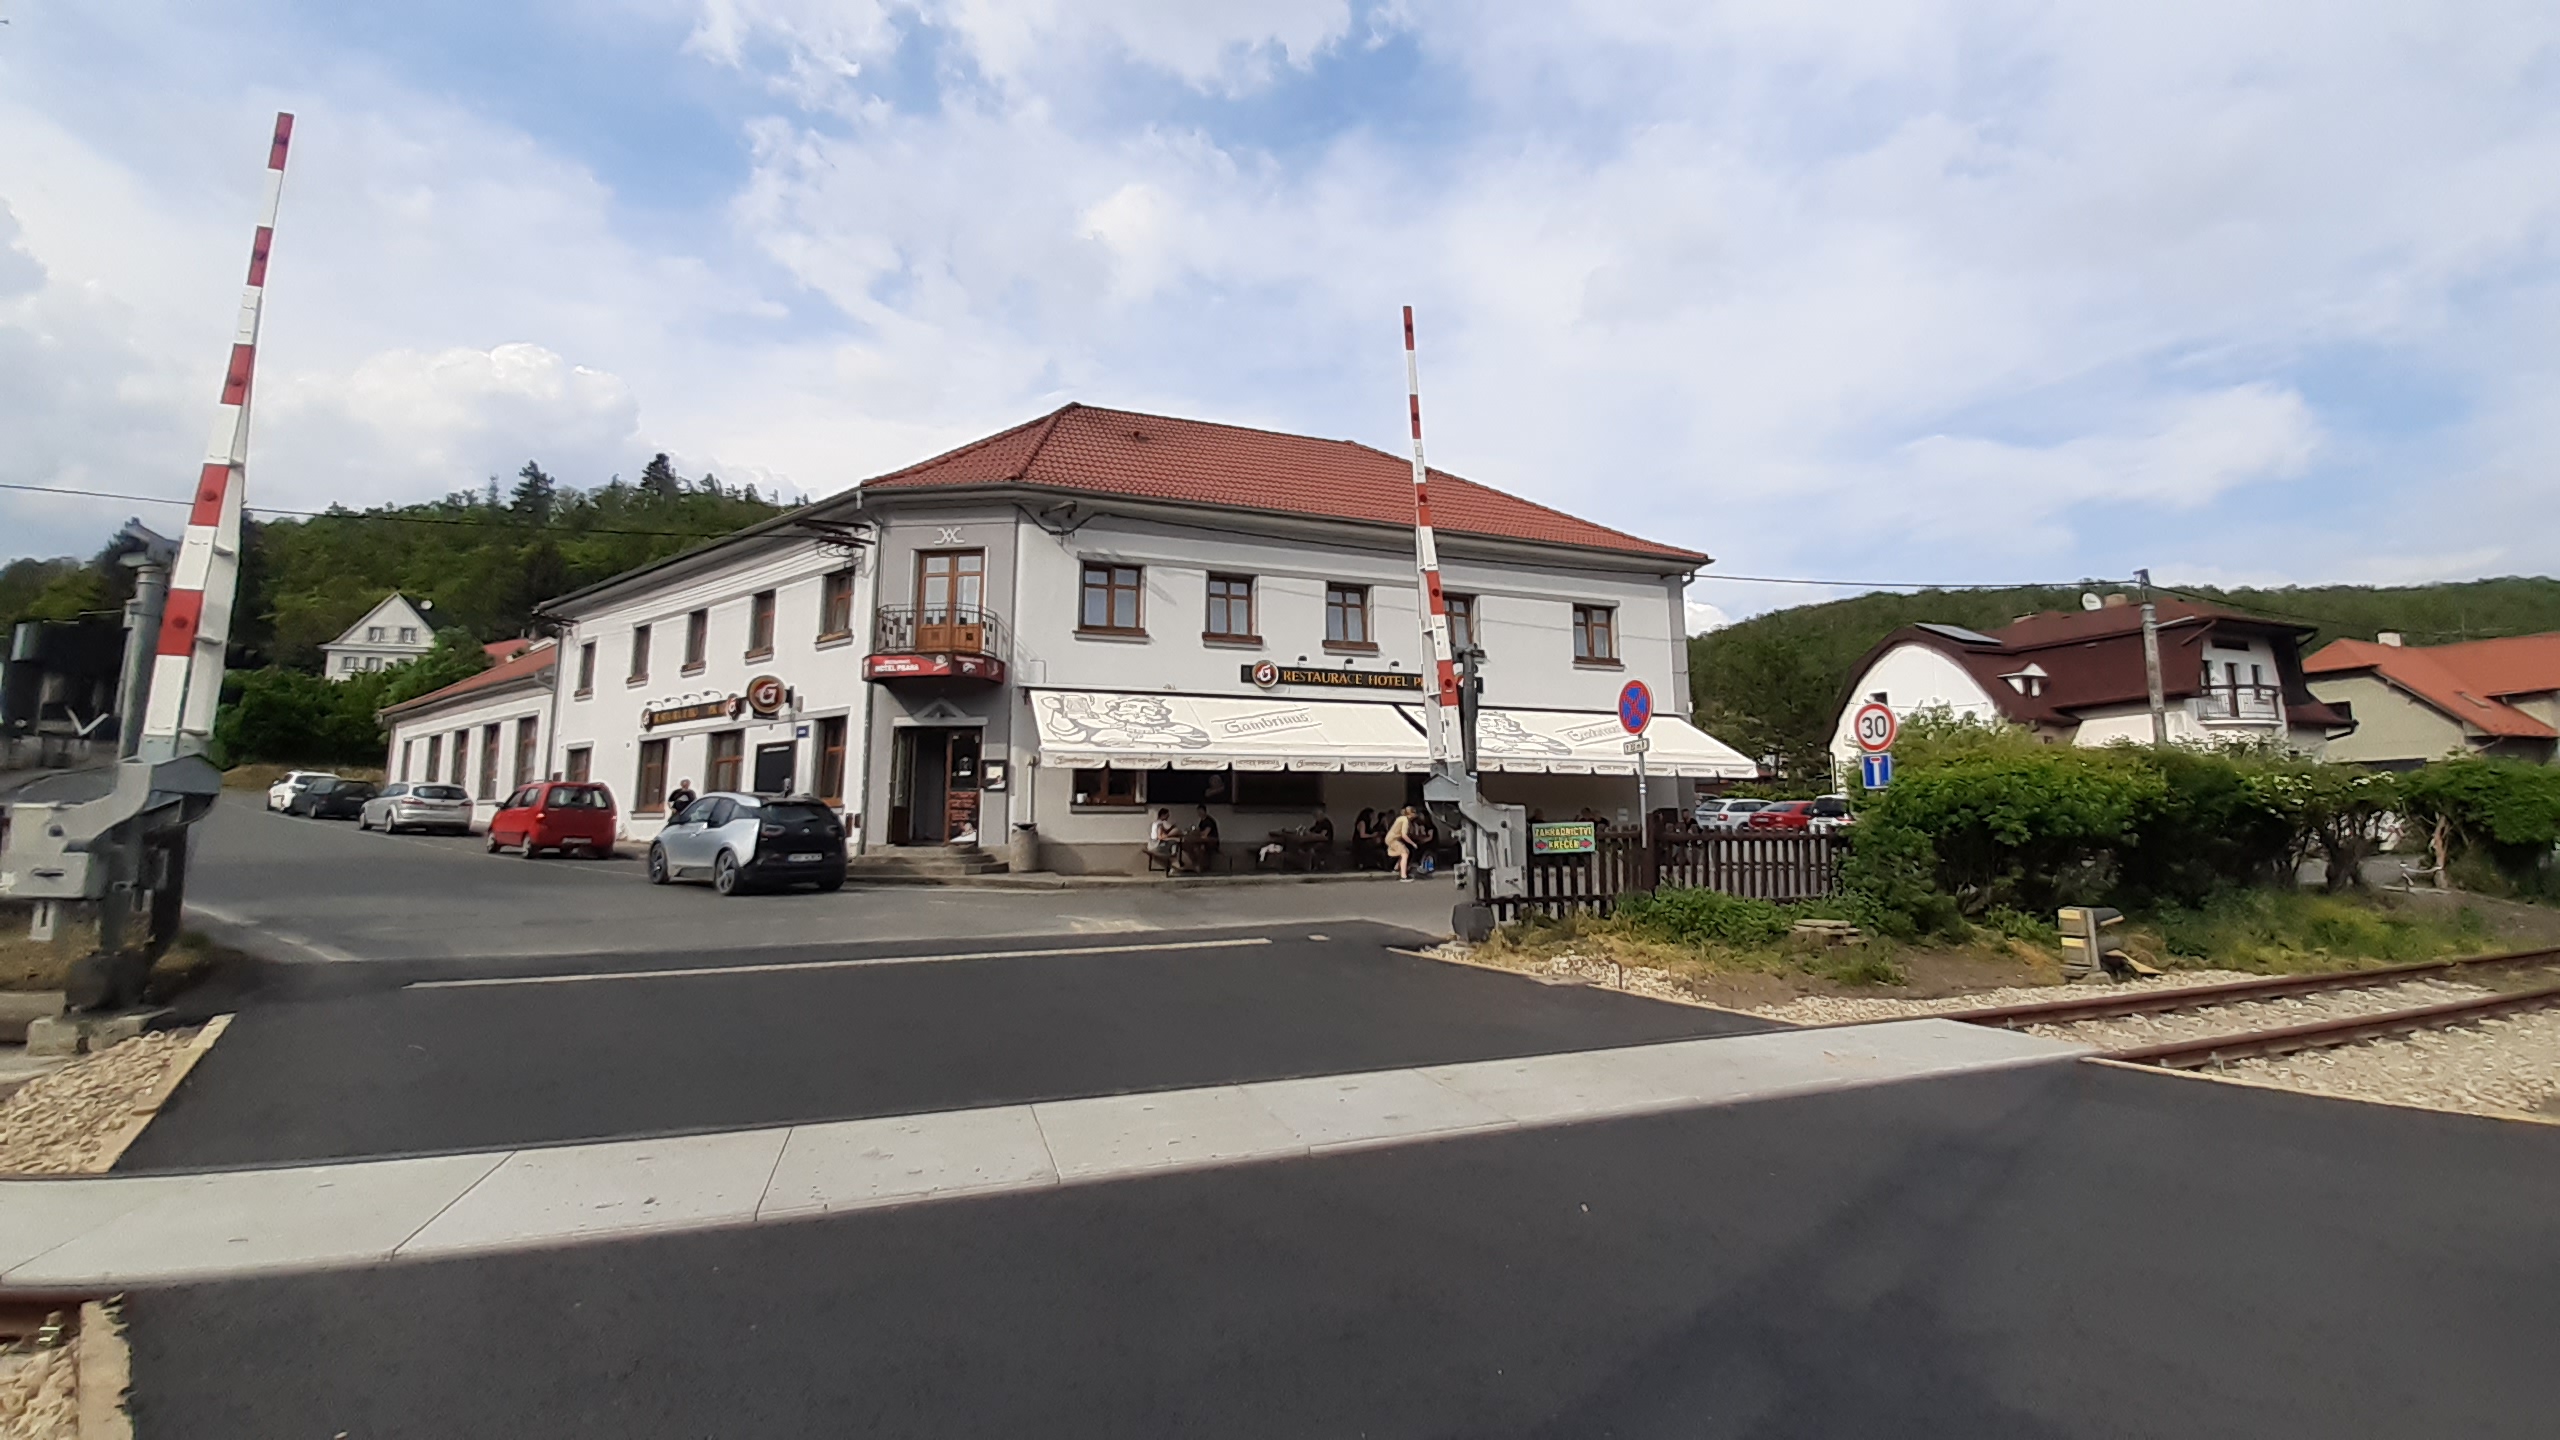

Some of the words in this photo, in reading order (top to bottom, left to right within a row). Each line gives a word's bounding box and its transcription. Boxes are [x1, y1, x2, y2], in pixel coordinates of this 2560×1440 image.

[1283, 669, 1363, 686] RESTAURACE
[1368, 674, 1408, 687] HOTEL
[1224, 713, 1310, 734] Gambrinus
[1861, 715, 1887, 739] 30
